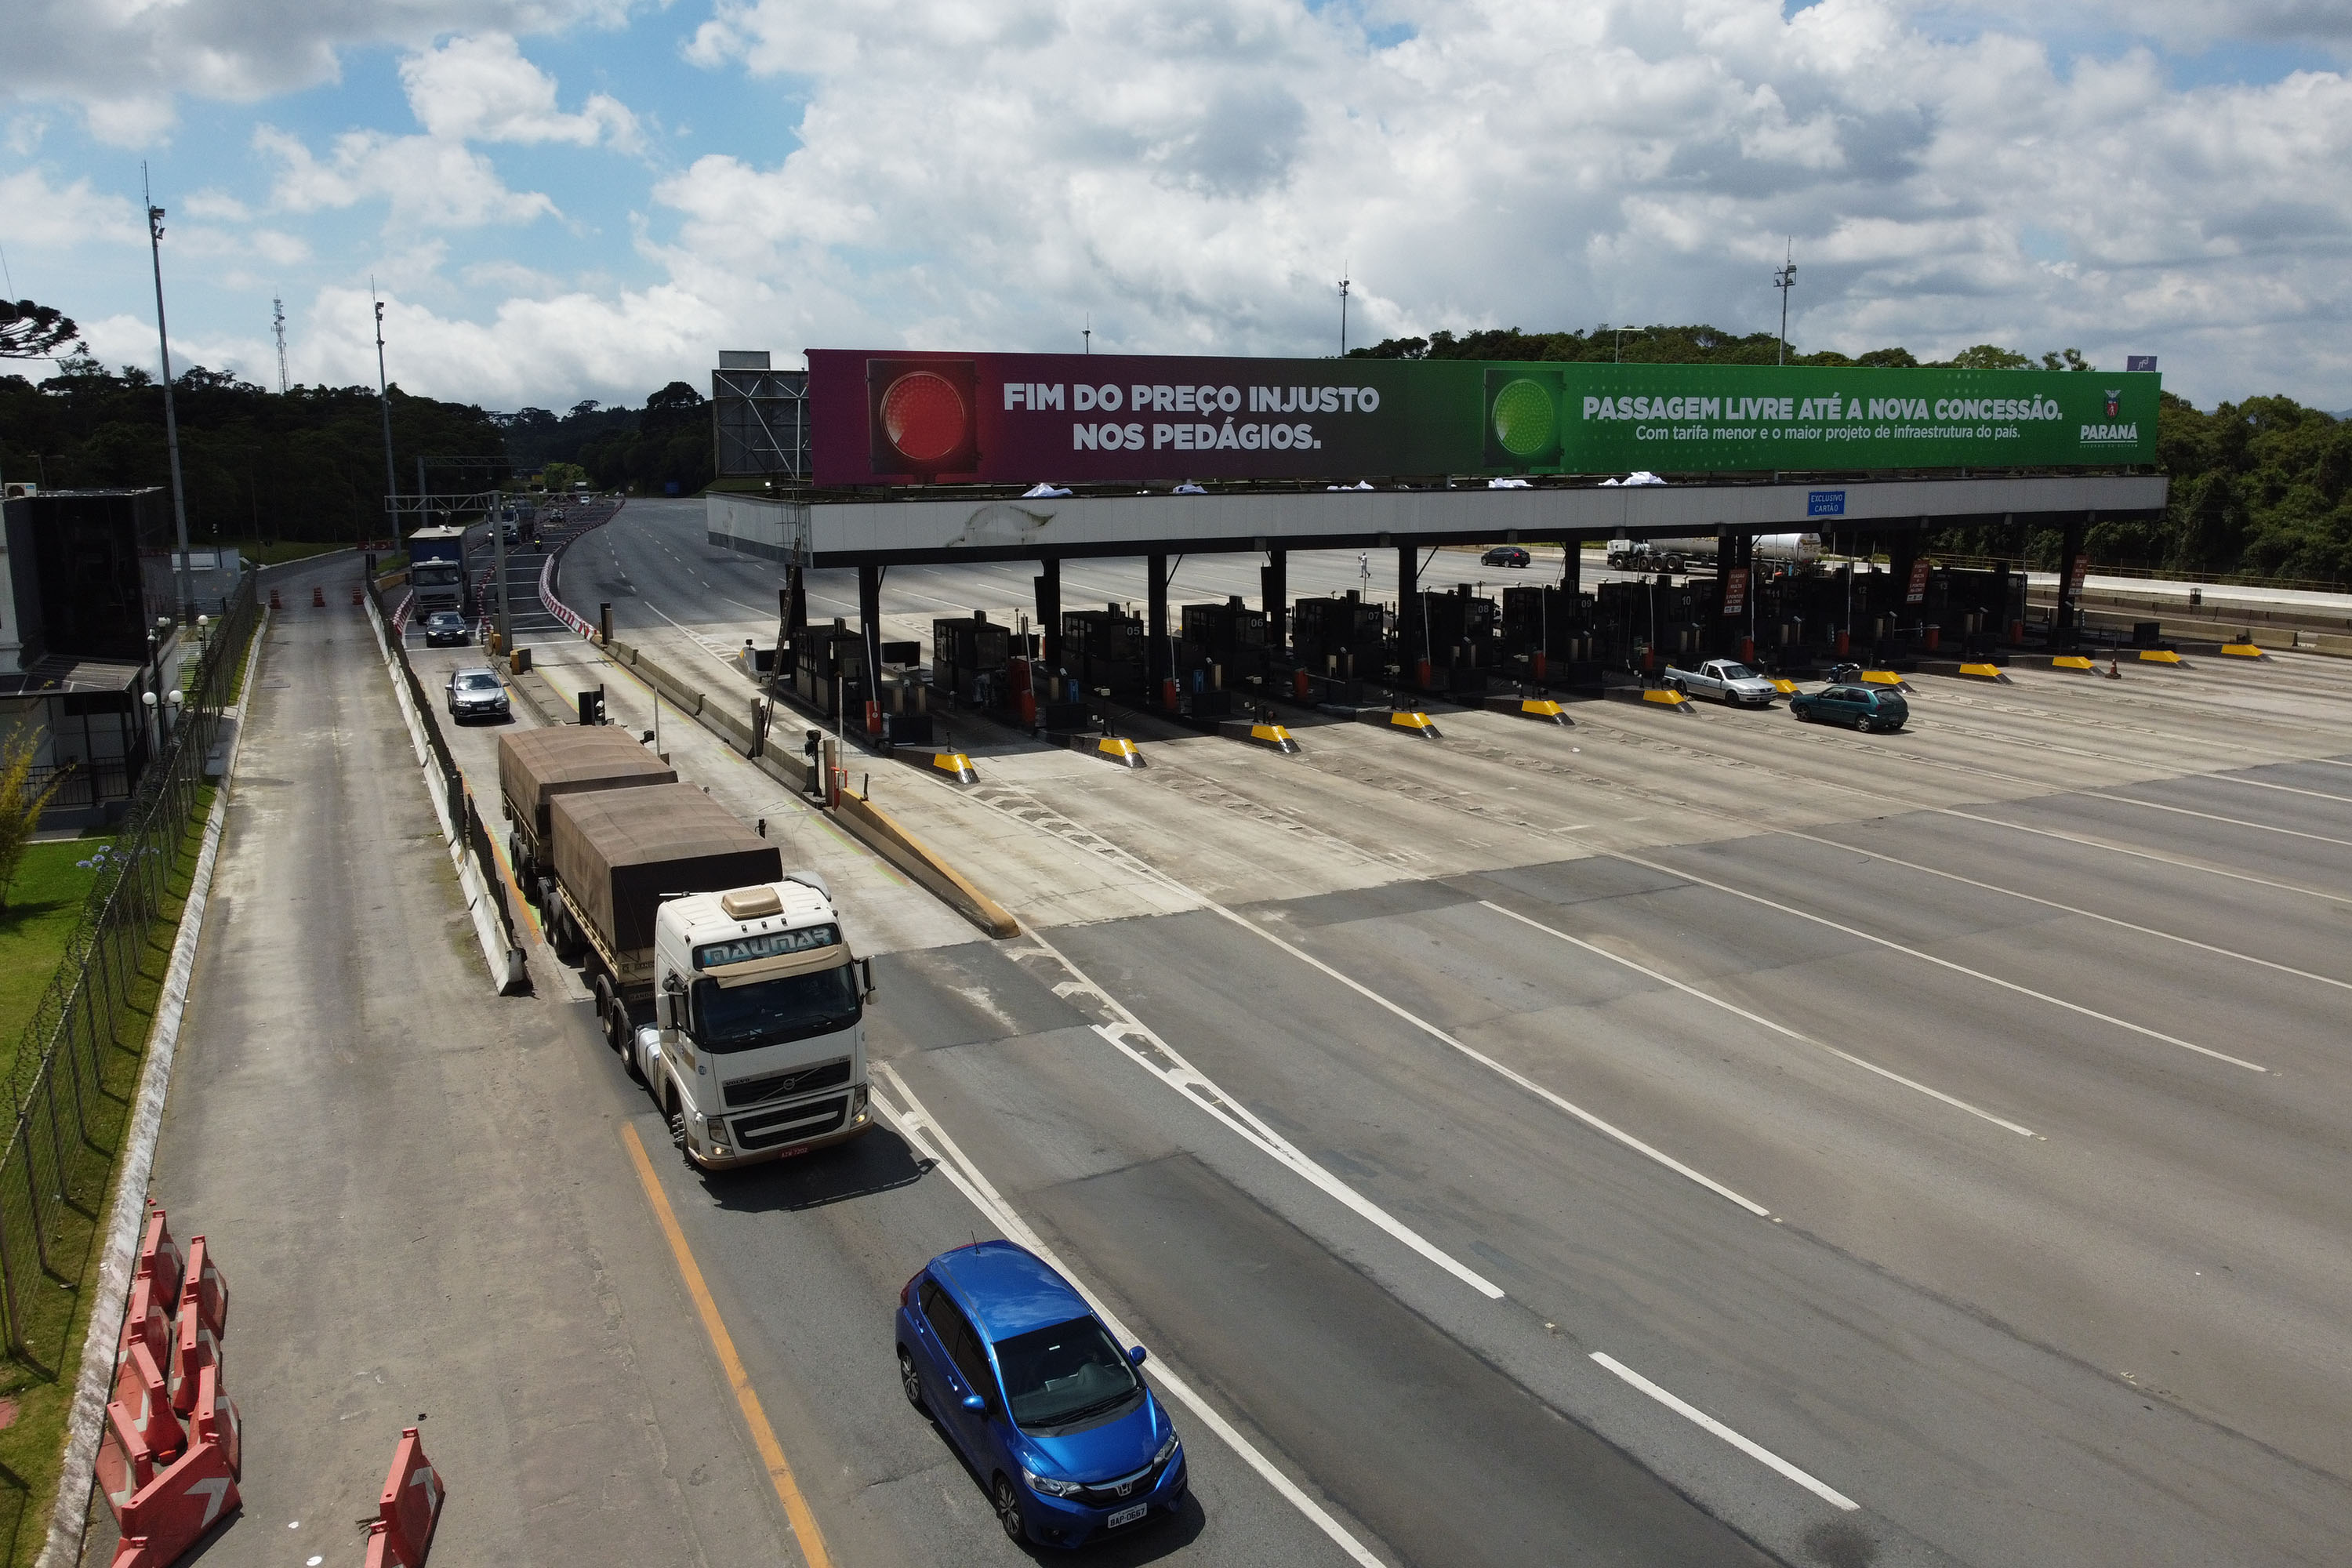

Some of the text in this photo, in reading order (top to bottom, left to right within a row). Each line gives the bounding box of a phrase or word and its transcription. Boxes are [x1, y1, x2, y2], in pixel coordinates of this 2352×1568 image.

[1004, 383, 1380, 417] FIM DO PREÇO INJUSTO
[1582, 392, 2063, 421] PASSAGEM LIVRE ATÉ A NOVA CONCESSÃO.
[1073, 416, 1322, 451] NOS PEDÁGIOS.
[1635, 424, 2021, 443] Com tarifa menor e o maior projeto de infraestrutura do país.
[2080, 422, 2138, 440] PARANÁ
[1810, 494, 1842, 503] EXCLUSIVO
[1814, 503, 1838, 513] CARTÃO
[1858, 586, 1867, 594] 12
[1939, 582, 1948, 590] 13
[1771, 590, 1780, 598] 11
[1581, 599, 1592, 608] 09
[1681, 595, 1692, 606] 10
[1478, 604, 1490, 614] 08
[1368, 611, 1380, 620] 07
[1250, 618, 1264, 628] 06
[1127, 626, 1141, 636] 05
[725, 1077, 750, 1087] VOLVO
[1109, 1508, 1145, 1526] BAP-0667
